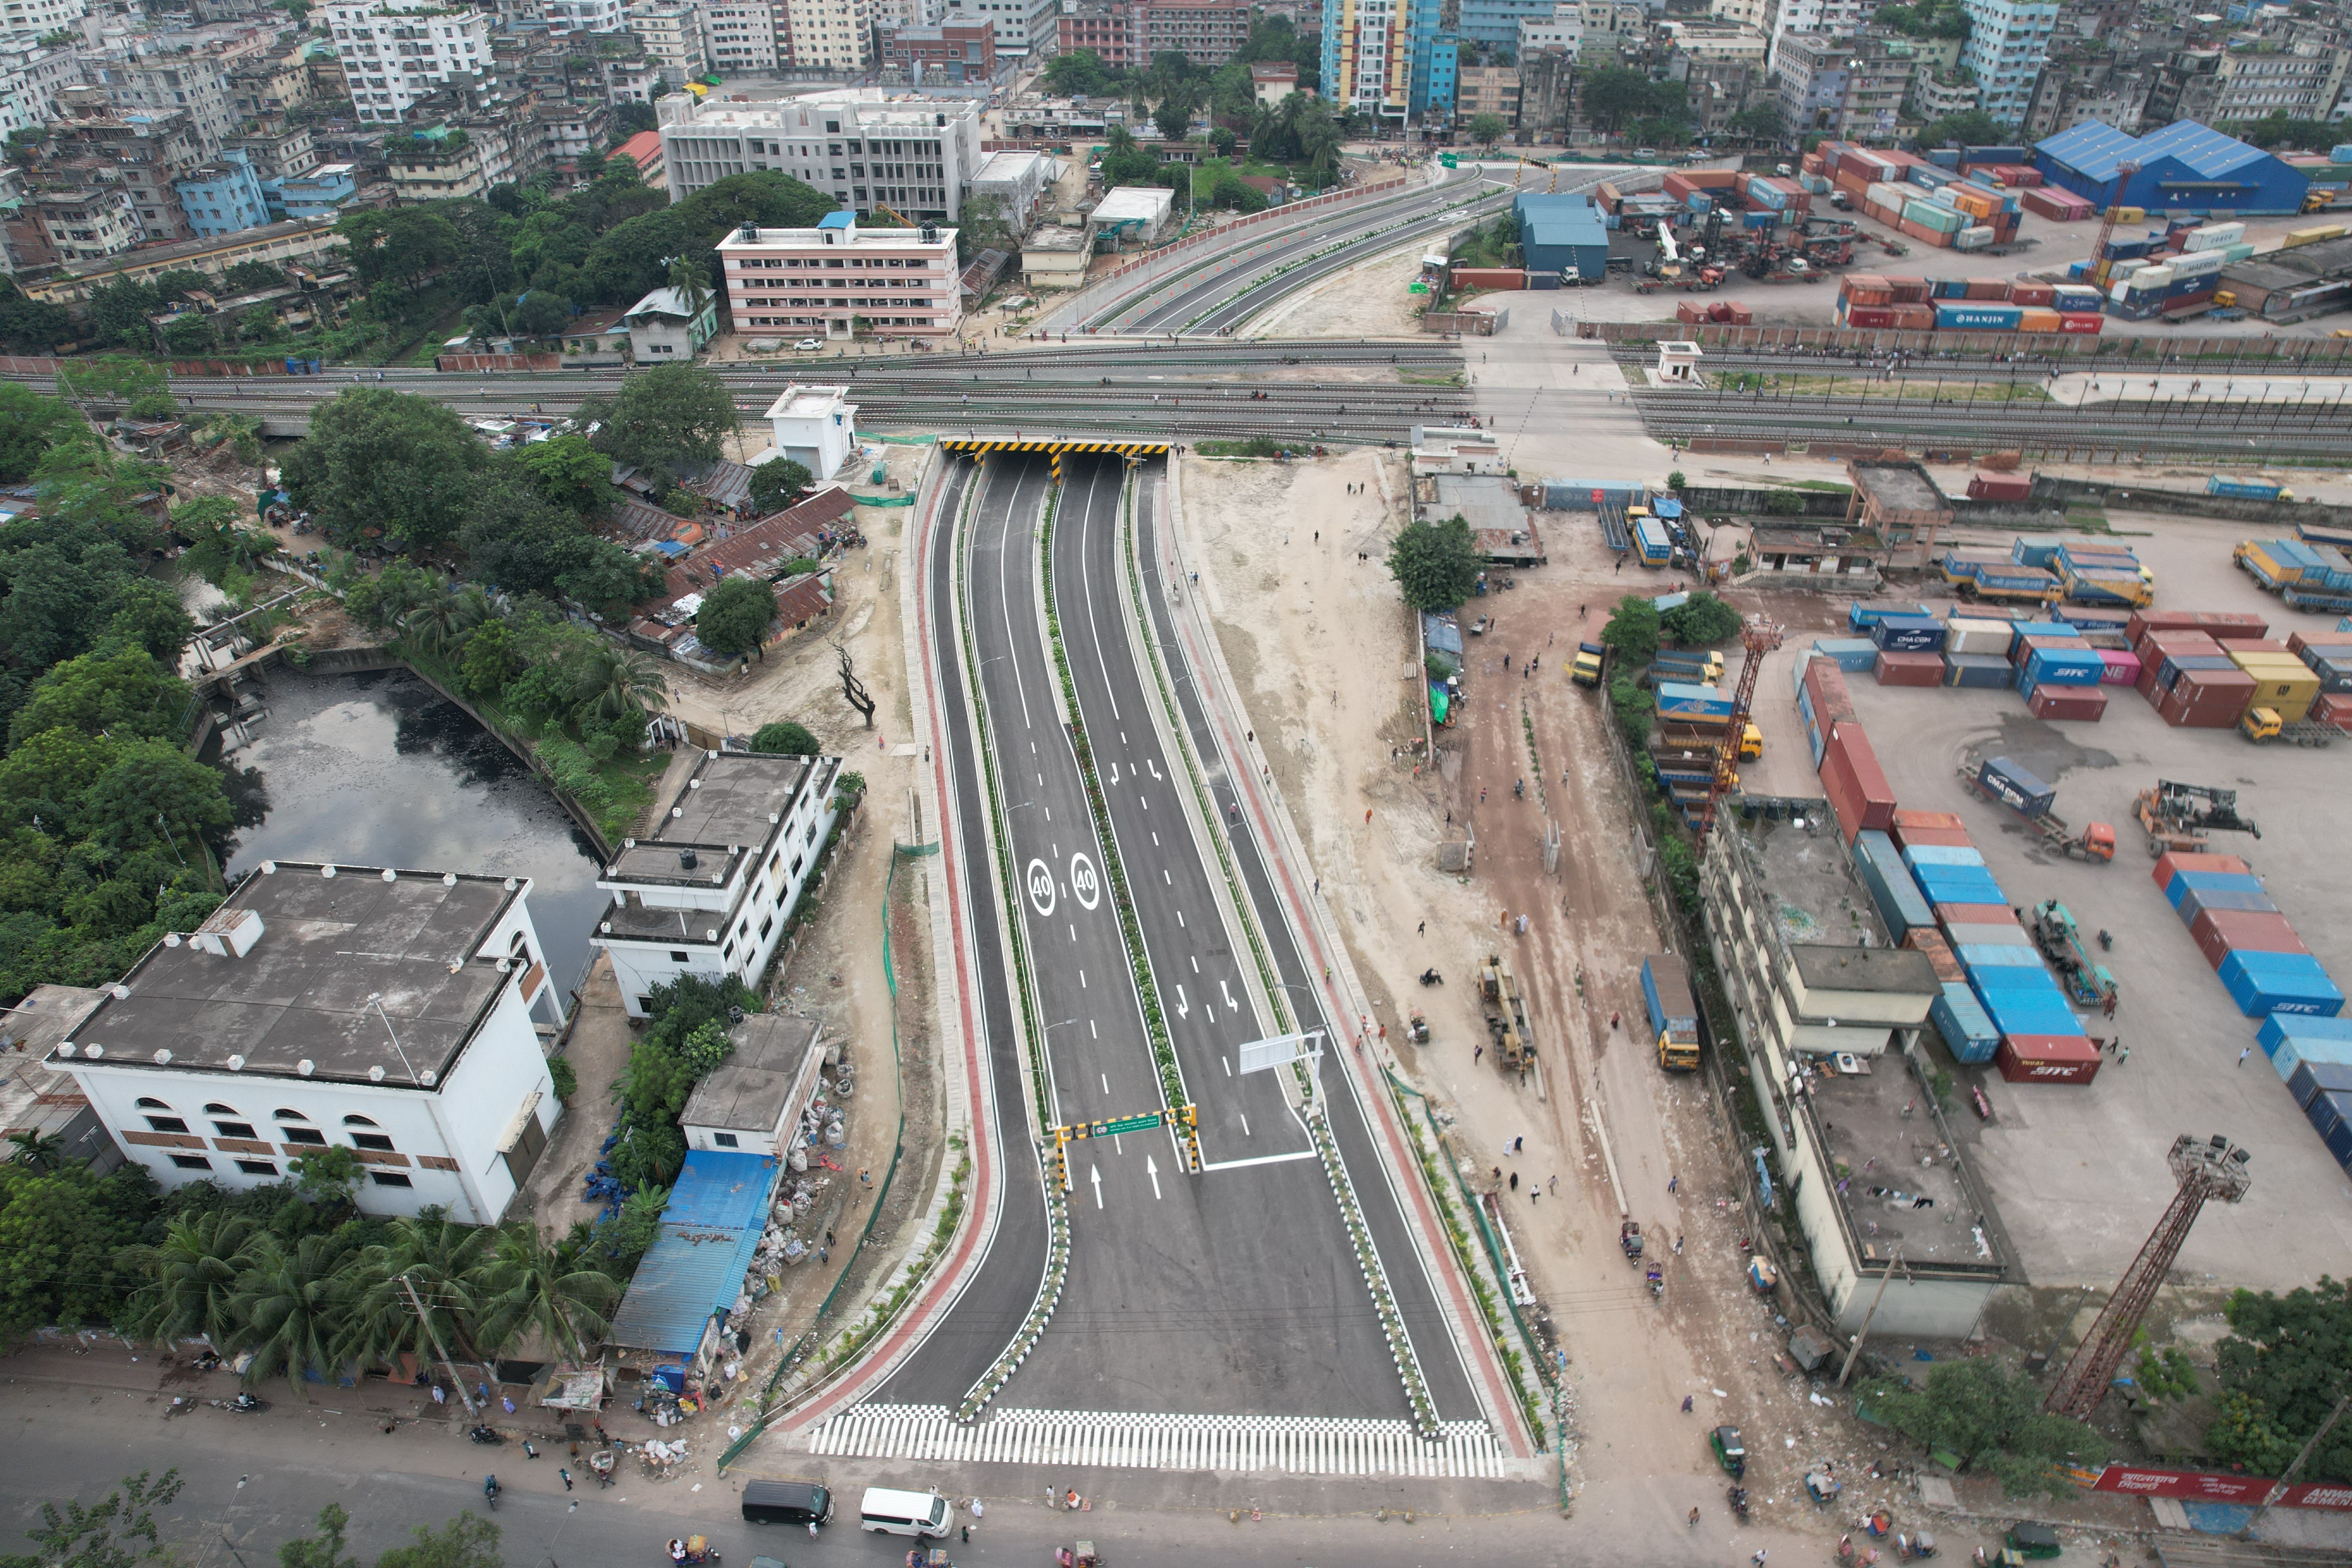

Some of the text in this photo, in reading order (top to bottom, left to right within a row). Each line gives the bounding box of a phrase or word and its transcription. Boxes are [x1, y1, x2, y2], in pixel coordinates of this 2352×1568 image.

[1966, 315, 2004, 324] HANJIN
[2104, 665, 2127, 680] NE
[1987, 774, 2005, 793] CMA
[1033, 876, 1050, 897] 40
[1077, 870, 1094, 891] 40
[2301, 1496, 2352, 1507] CEMEN
